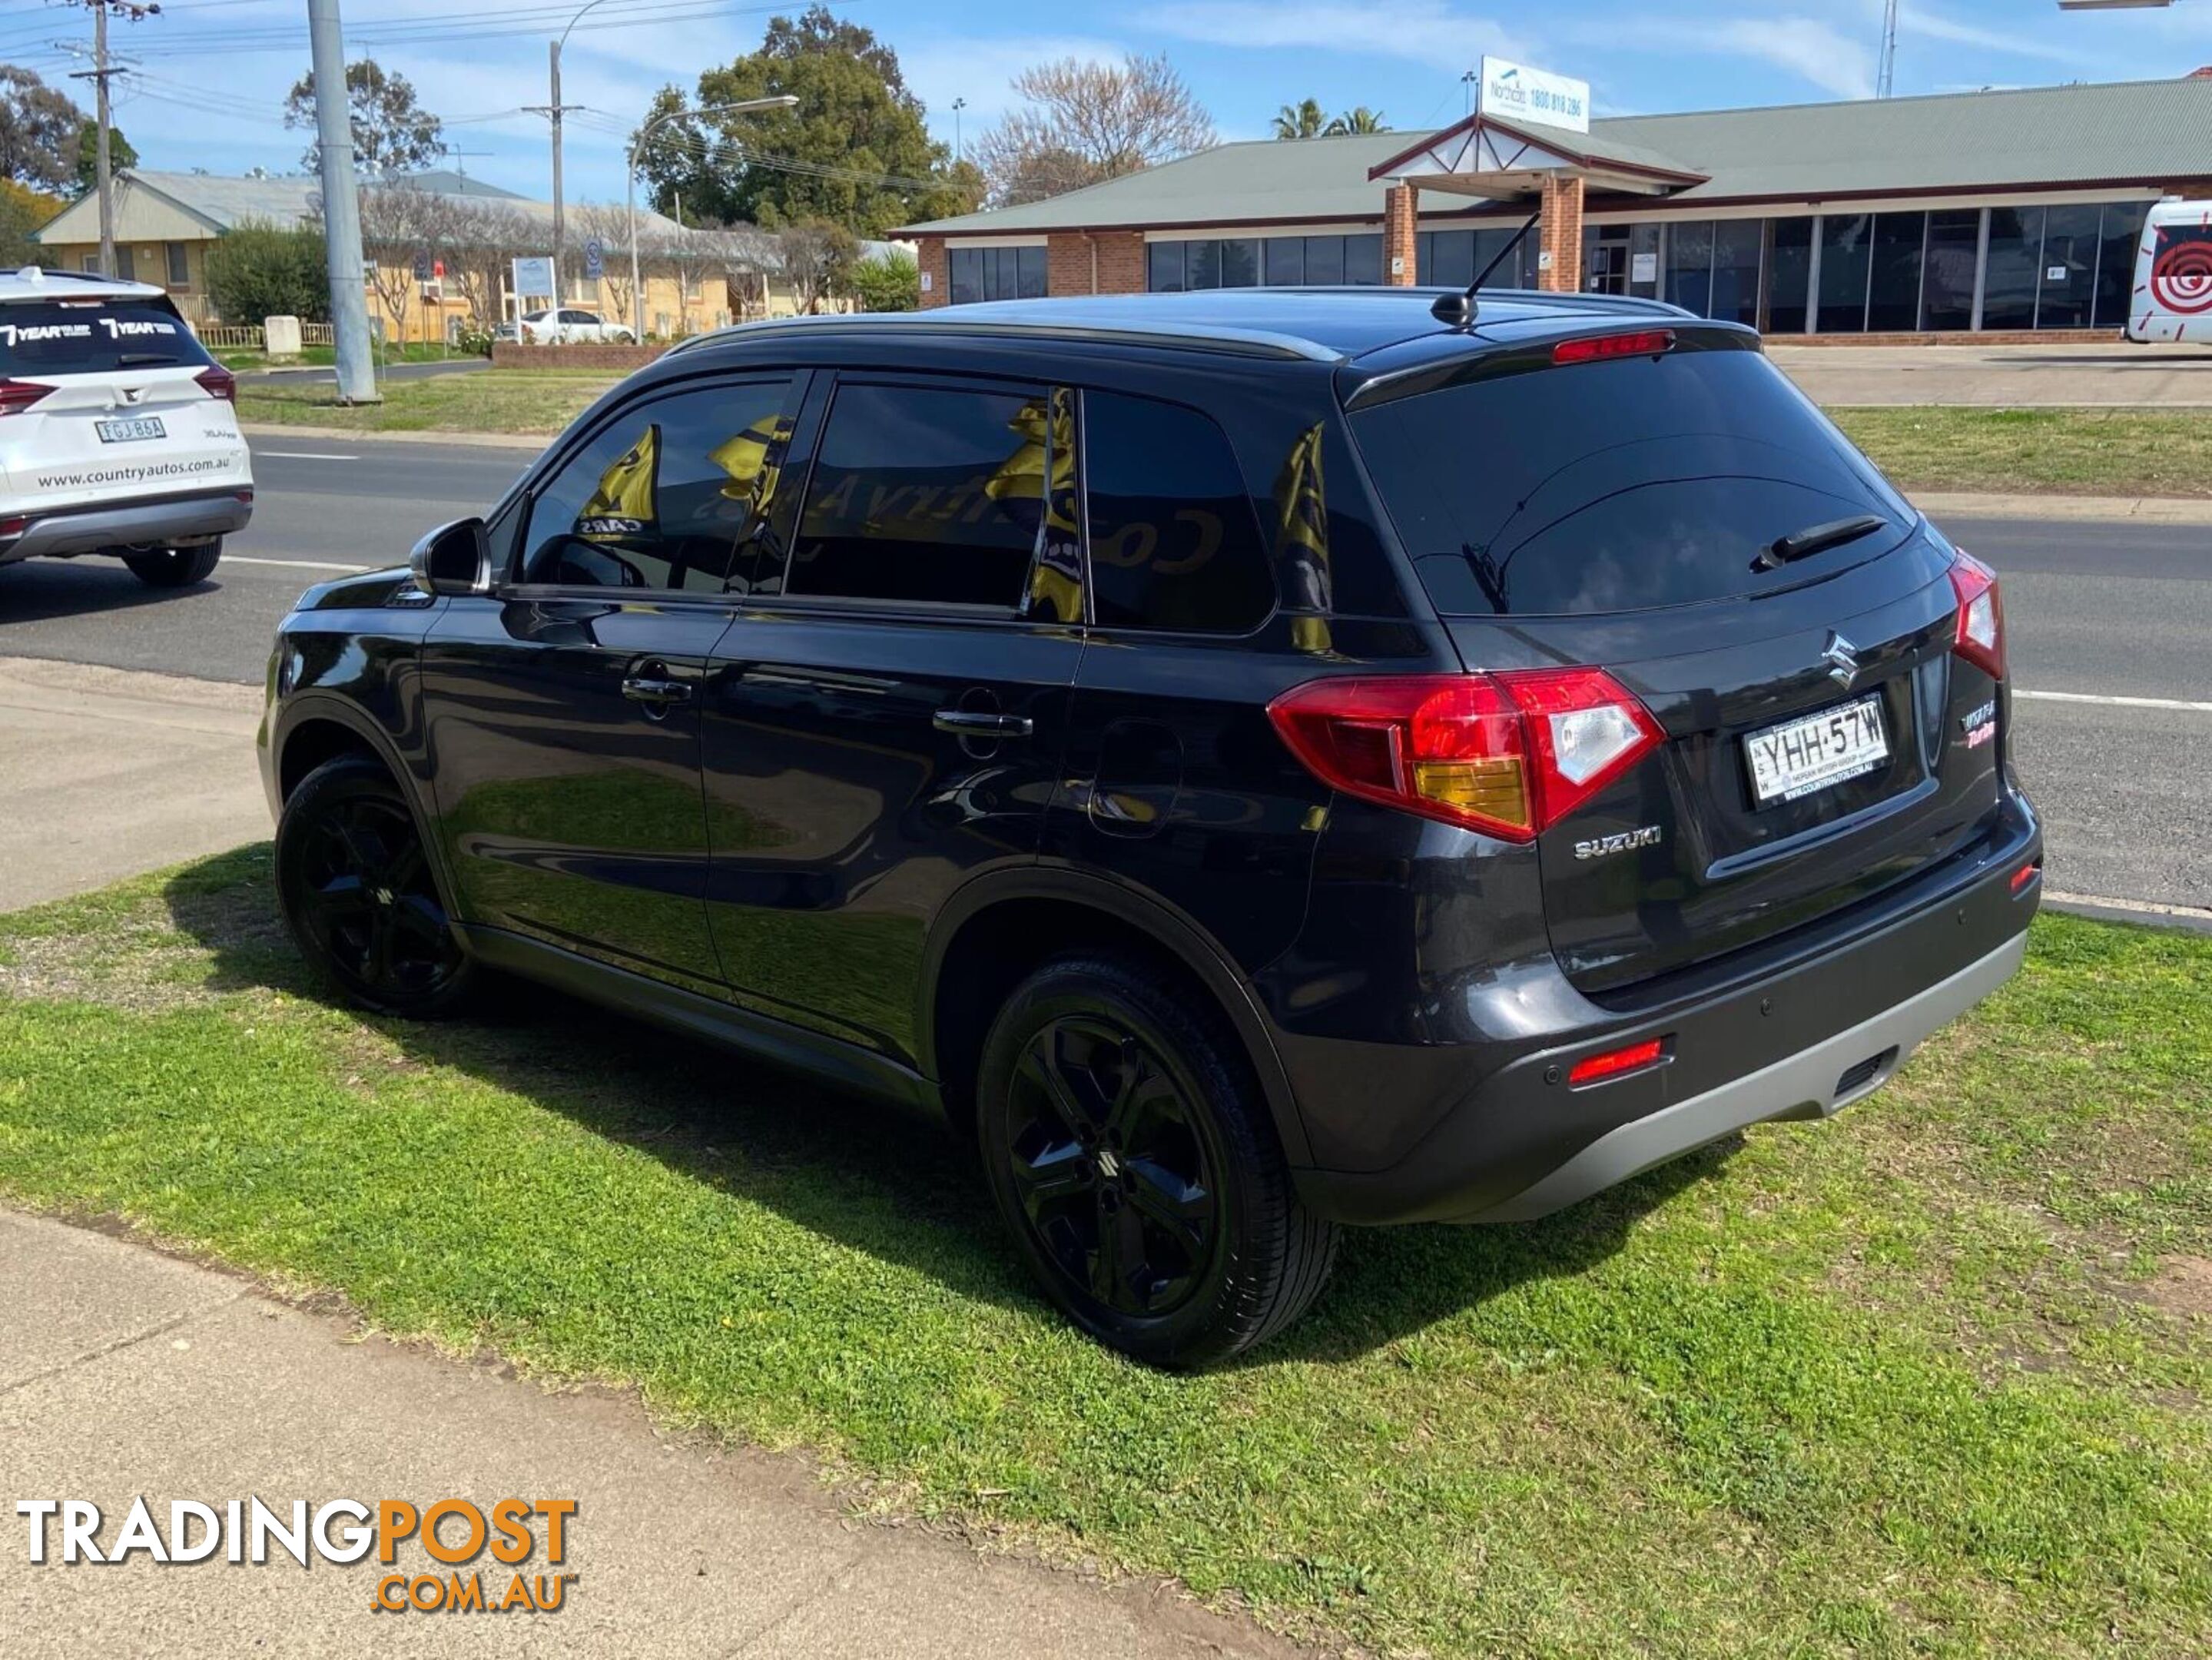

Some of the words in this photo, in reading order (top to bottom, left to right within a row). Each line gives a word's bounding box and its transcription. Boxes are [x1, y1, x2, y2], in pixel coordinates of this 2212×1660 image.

[1530, 88, 1550, 110] 1800
[0, 325, 16, 346] 7
[18, 326, 61, 340] YEAR
[98, 318, 118, 339] 7
[118, 323, 154, 334] YEAR
[38, 458, 230, 488] www.countryautos.com.au
[1574, 825, 1661, 859] SUZUKI
